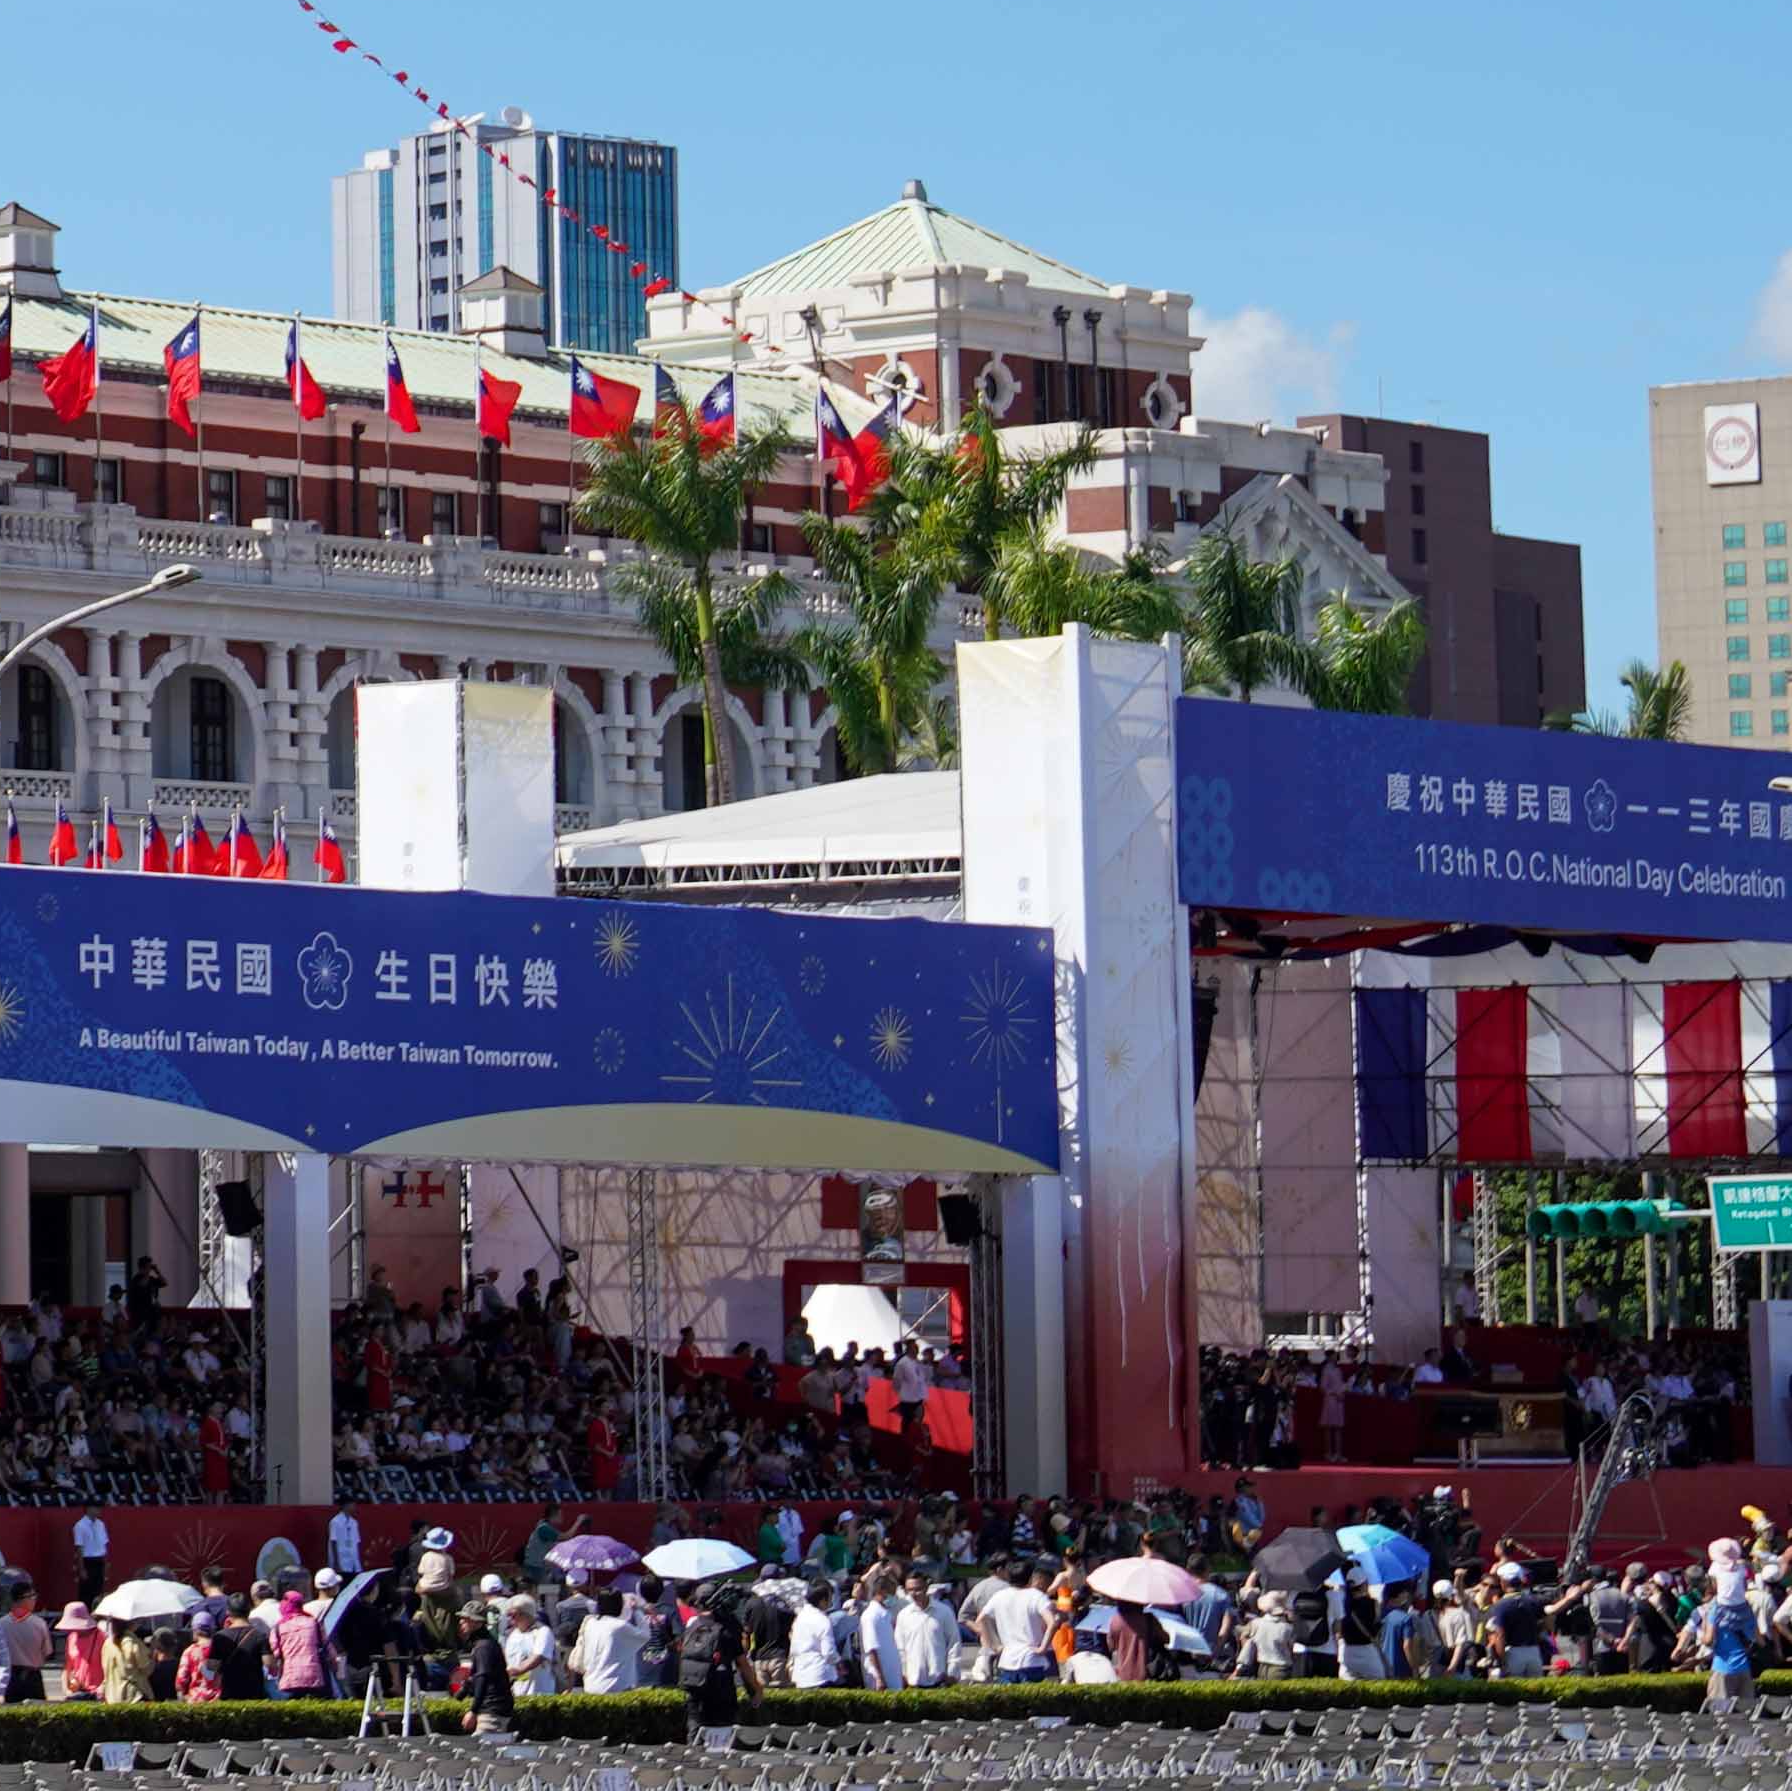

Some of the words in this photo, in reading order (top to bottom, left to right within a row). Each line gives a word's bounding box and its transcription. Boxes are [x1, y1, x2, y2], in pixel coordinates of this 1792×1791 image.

[1386, 771, 1571, 824] 慶祝中華民國
[1415, 843, 1478, 876] 113th
[1552, 854, 1631, 889] National
[1636, 859, 1674, 897] Day
[1678, 862, 1786, 899] Celebration
[79, 934, 271, 996] 中華民國
[375, 949, 559, 1009] 生日快樂
[79, 1028, 93, 1048] A
[97, 1028, 182, 1052] Beautiful
[186, 1031, 250, 1055] Taiwan
[254, 1035, 317, 1062] Today,
[321, 1039, 335, 1059] A
[338, 1040, 395, 1062] Better
[399, 1042, 460, 1064] Taiwan
[464, 1045, 559, 1069] Tomorrow.
